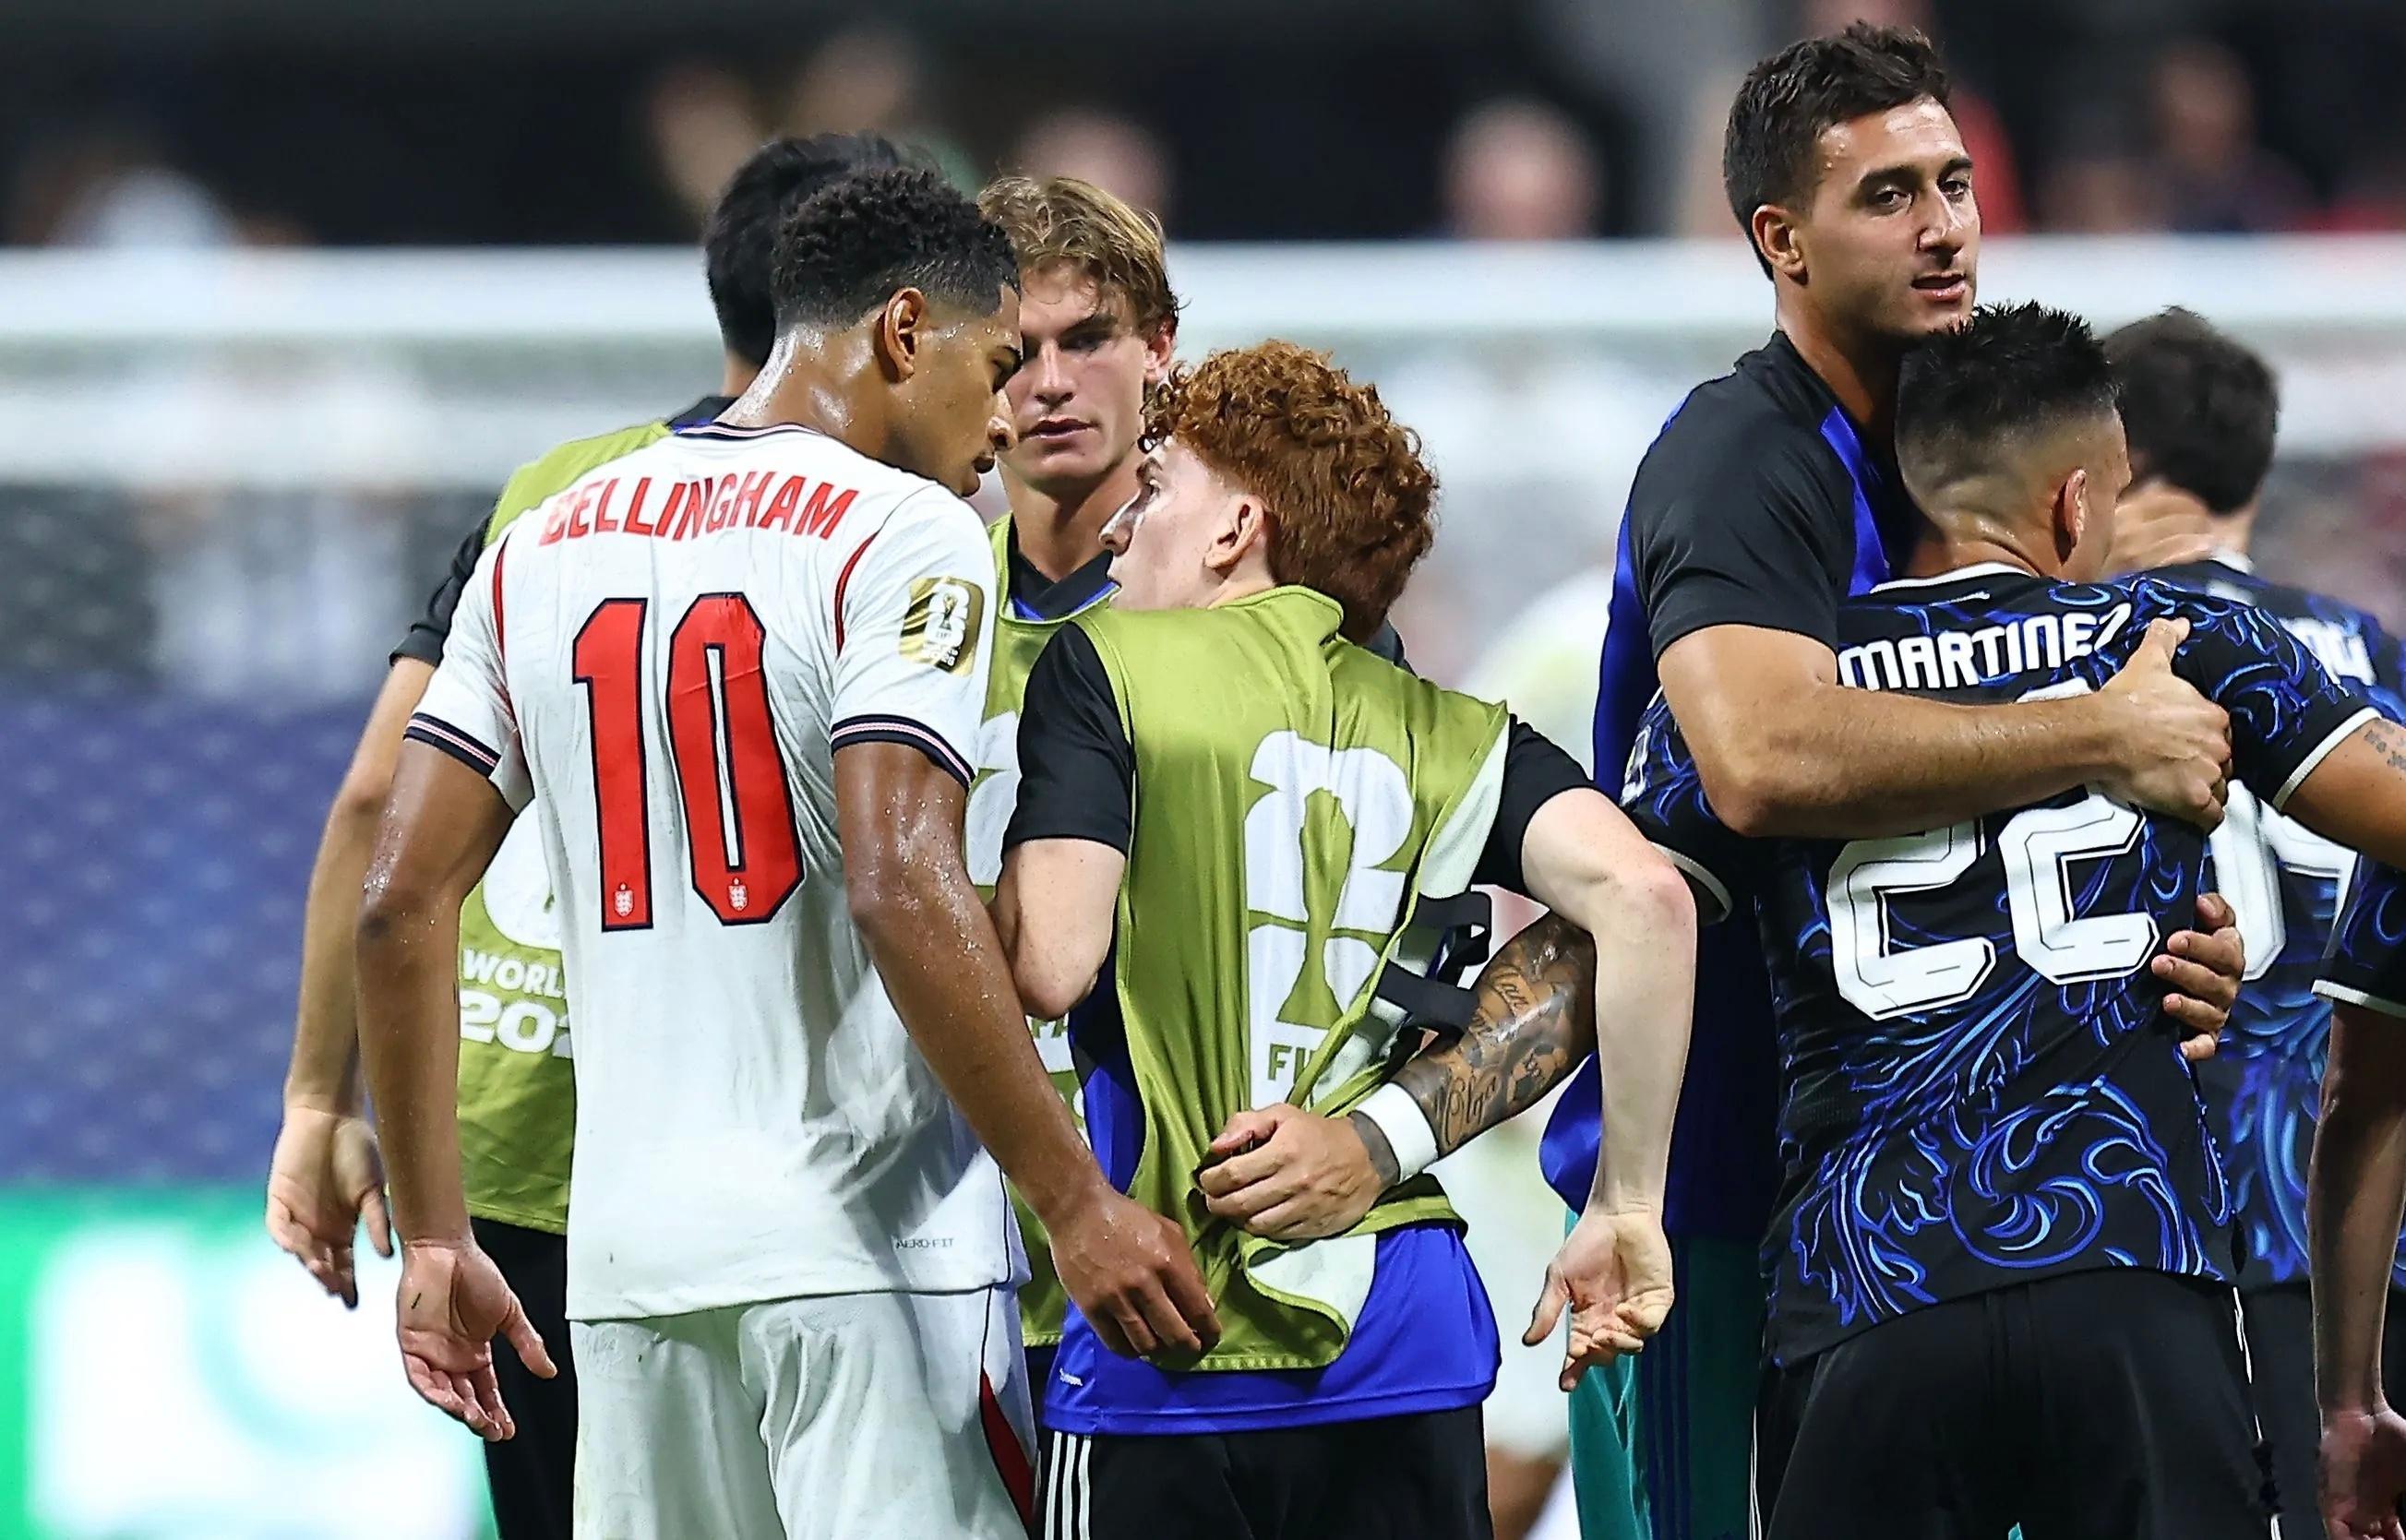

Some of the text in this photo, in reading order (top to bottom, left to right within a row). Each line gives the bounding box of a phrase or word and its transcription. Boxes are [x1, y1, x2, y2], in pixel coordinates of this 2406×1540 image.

[538, 471, 859, 547] BELLINGHAM
[572, 591, 806, 932] 10
[462, 948, 568, 998] WORL
